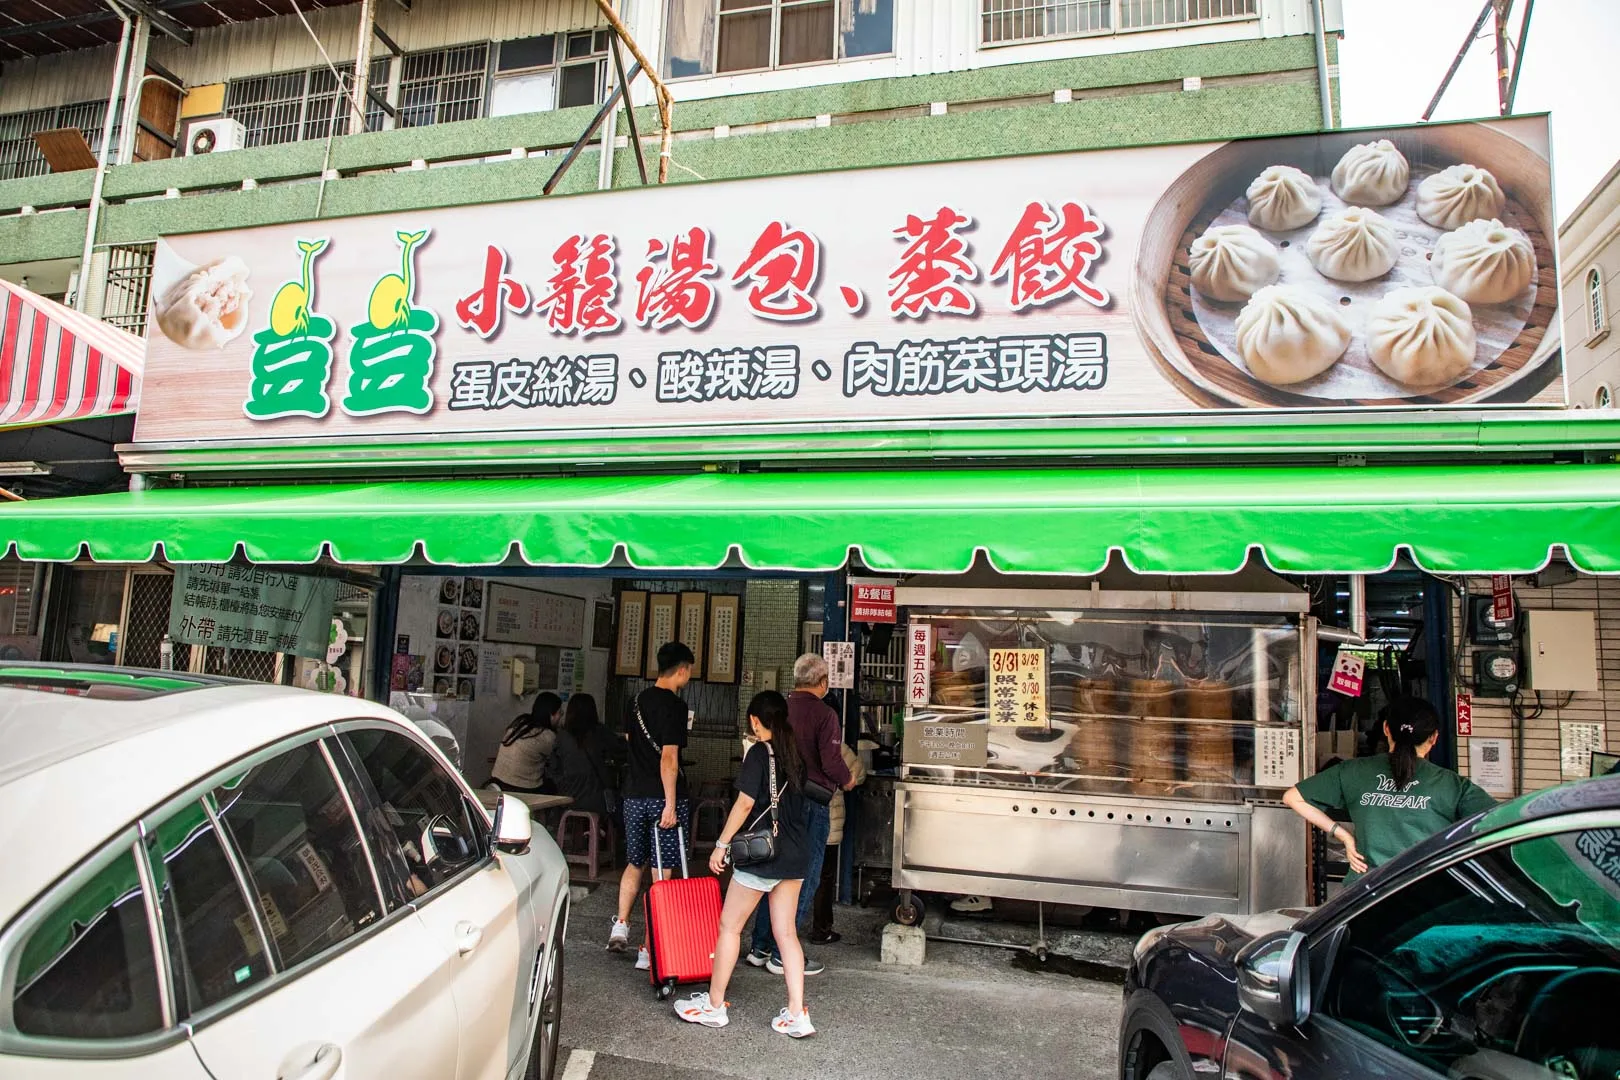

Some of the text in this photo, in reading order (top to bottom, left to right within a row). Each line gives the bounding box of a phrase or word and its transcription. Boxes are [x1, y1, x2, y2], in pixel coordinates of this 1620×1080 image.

[858, 588, 892, 600] 點餐區
[179, 615, 216, 640] 外帶
[912, 630, 926, 699] 每週五公休
[1021, 653, 1039, 666] 3/29
[993, 651, 1019, 723] 3/31 照常營業
[1021, 682, 1039, 695] 3/30
[1023, 702, 1039, 721] 休息
[1360, 792, 1431, 809] STREAK
